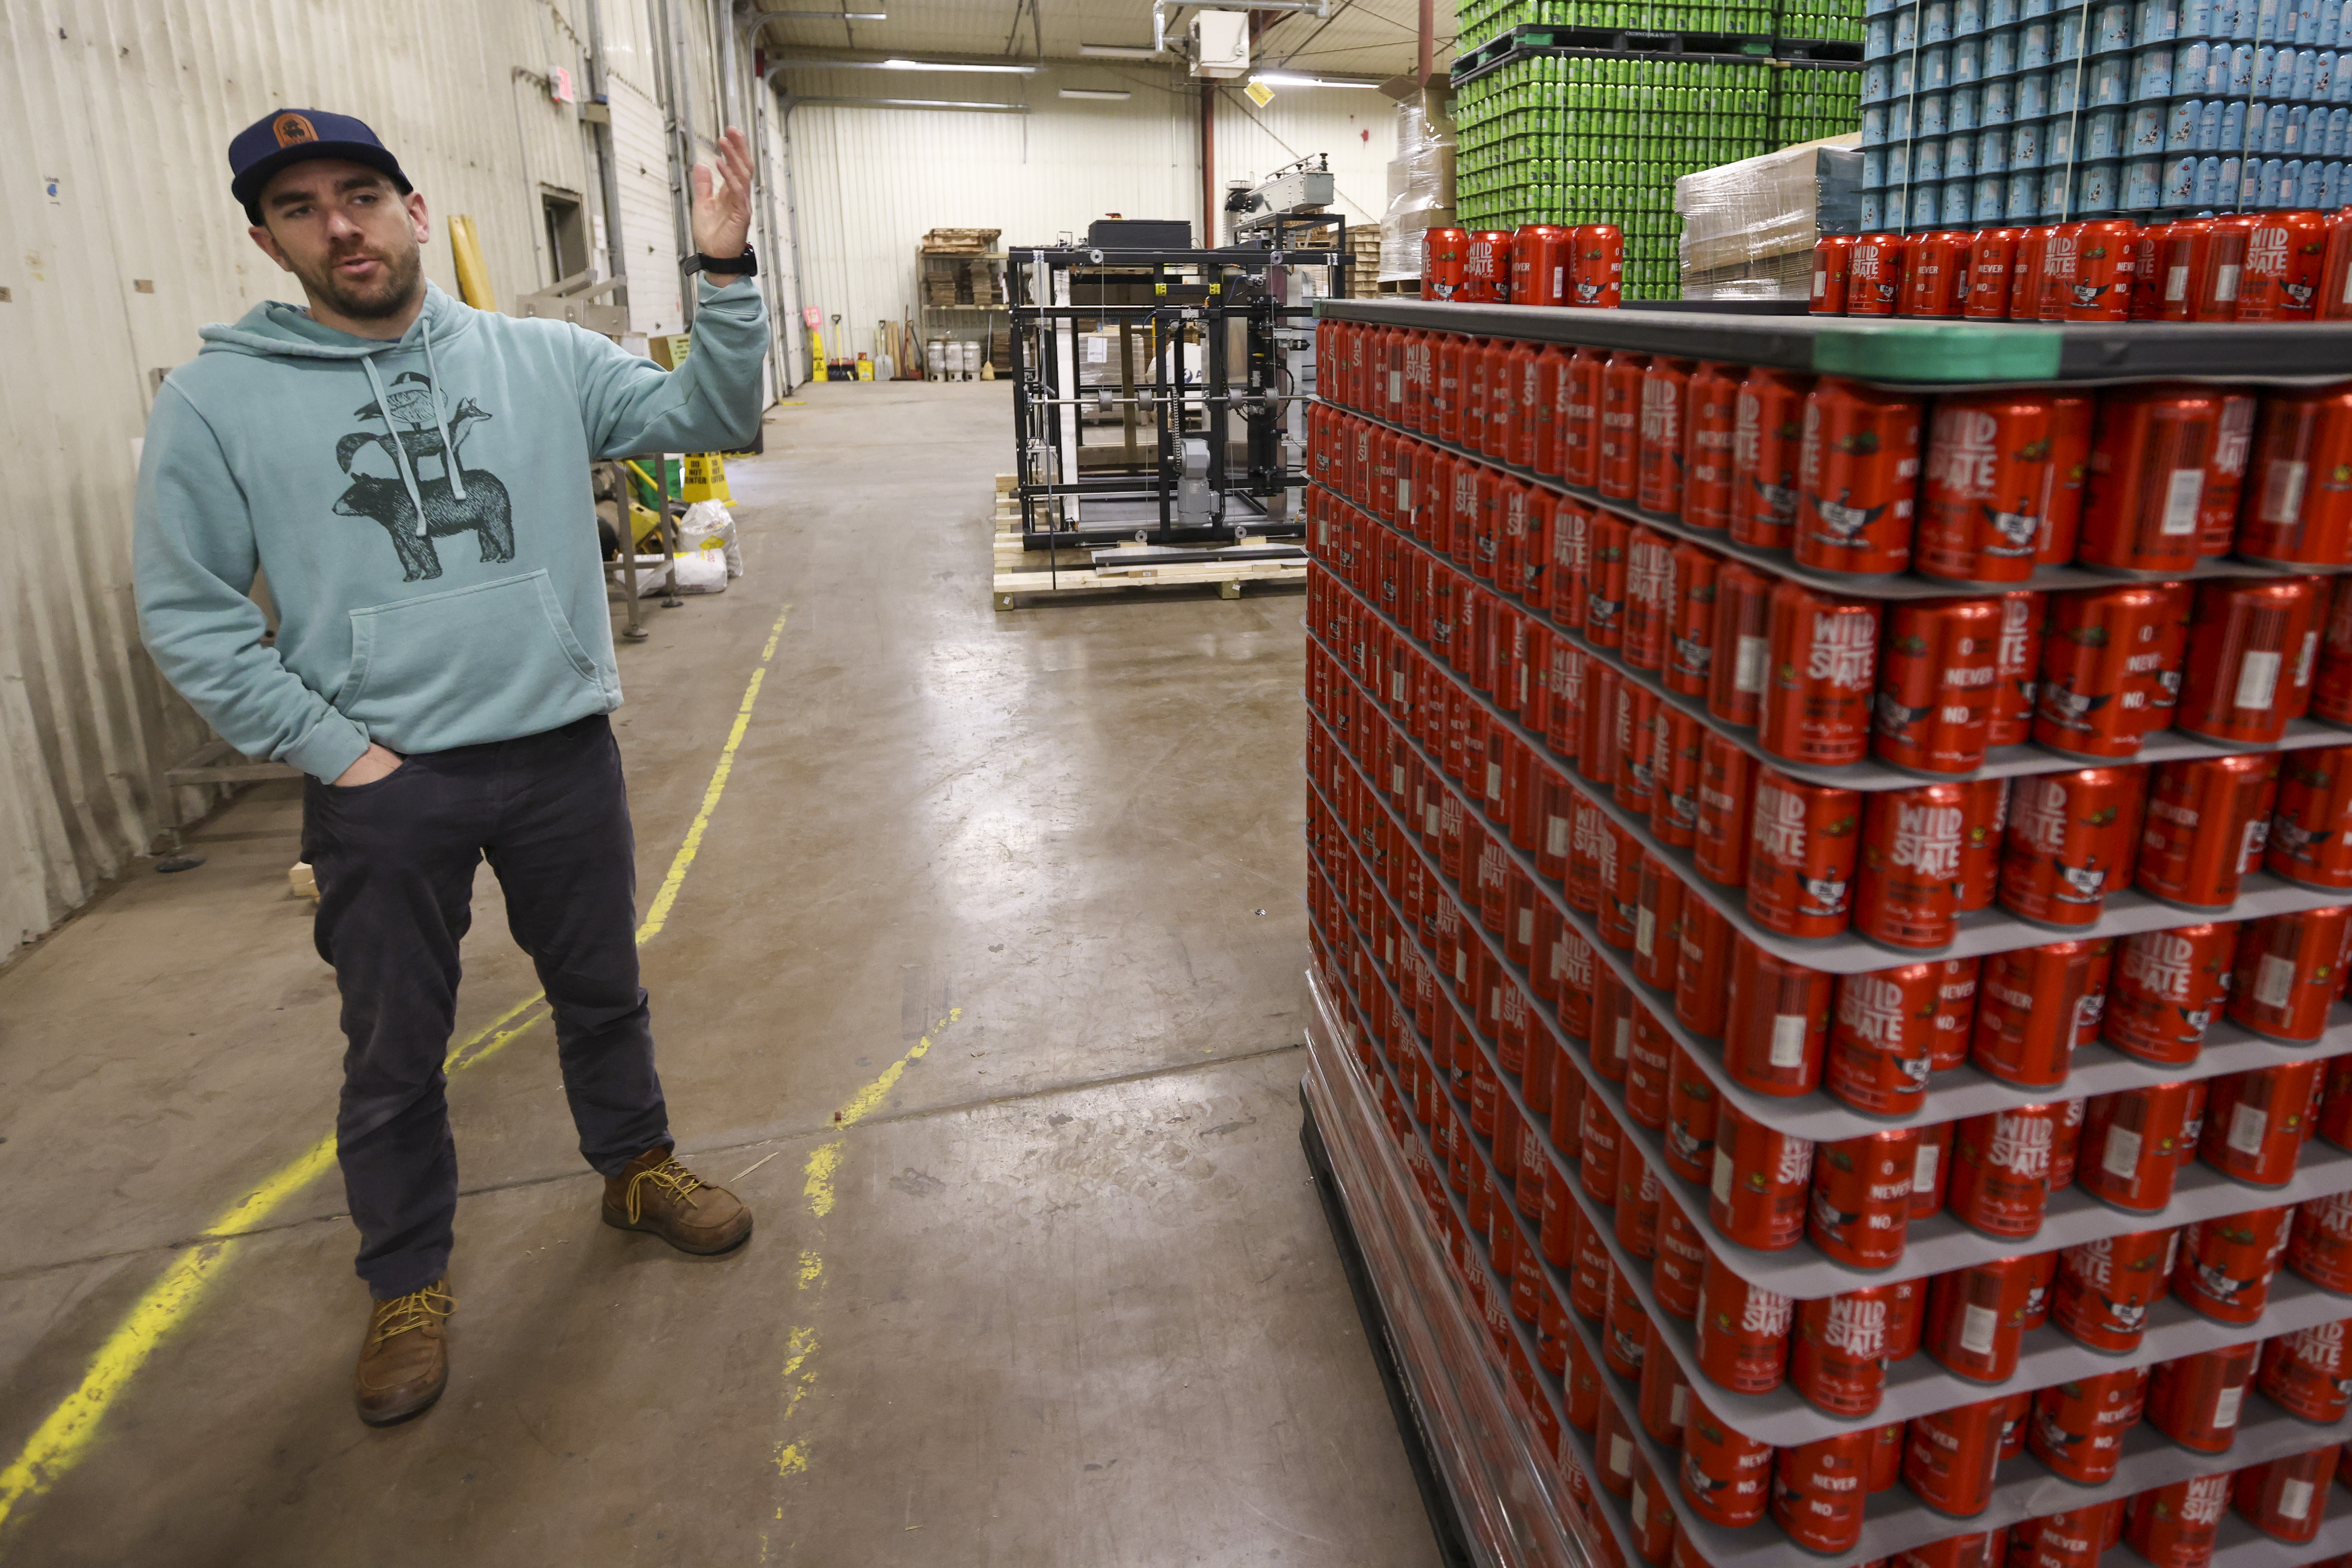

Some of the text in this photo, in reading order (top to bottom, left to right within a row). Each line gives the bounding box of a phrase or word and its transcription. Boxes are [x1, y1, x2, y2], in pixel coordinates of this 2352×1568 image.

[2250, 228, 2288, 250] WILD
[1854, 245, 1879, 261] WILD
[2246, 248, 2288, 274] STATE
[1852, 259, 1879, 277] STATE
[1977, 283, 1987, 291] NO
[2115, 283, 2126, 292] NO
[1945, 666, 1994, 685] NEVER
[1942, 706, 1969, 724] NO
[1897, 801, 1963, 839] WILD
[1891, 832, 1962, 875] STATE
[1869, 1214, 1891, 1229] NO
[1812, 1473, 1858, 1491] NEVER
[1811, 1499, 1832, 1517] NO
[2043, 1527, 2088, 1552] NEVER
